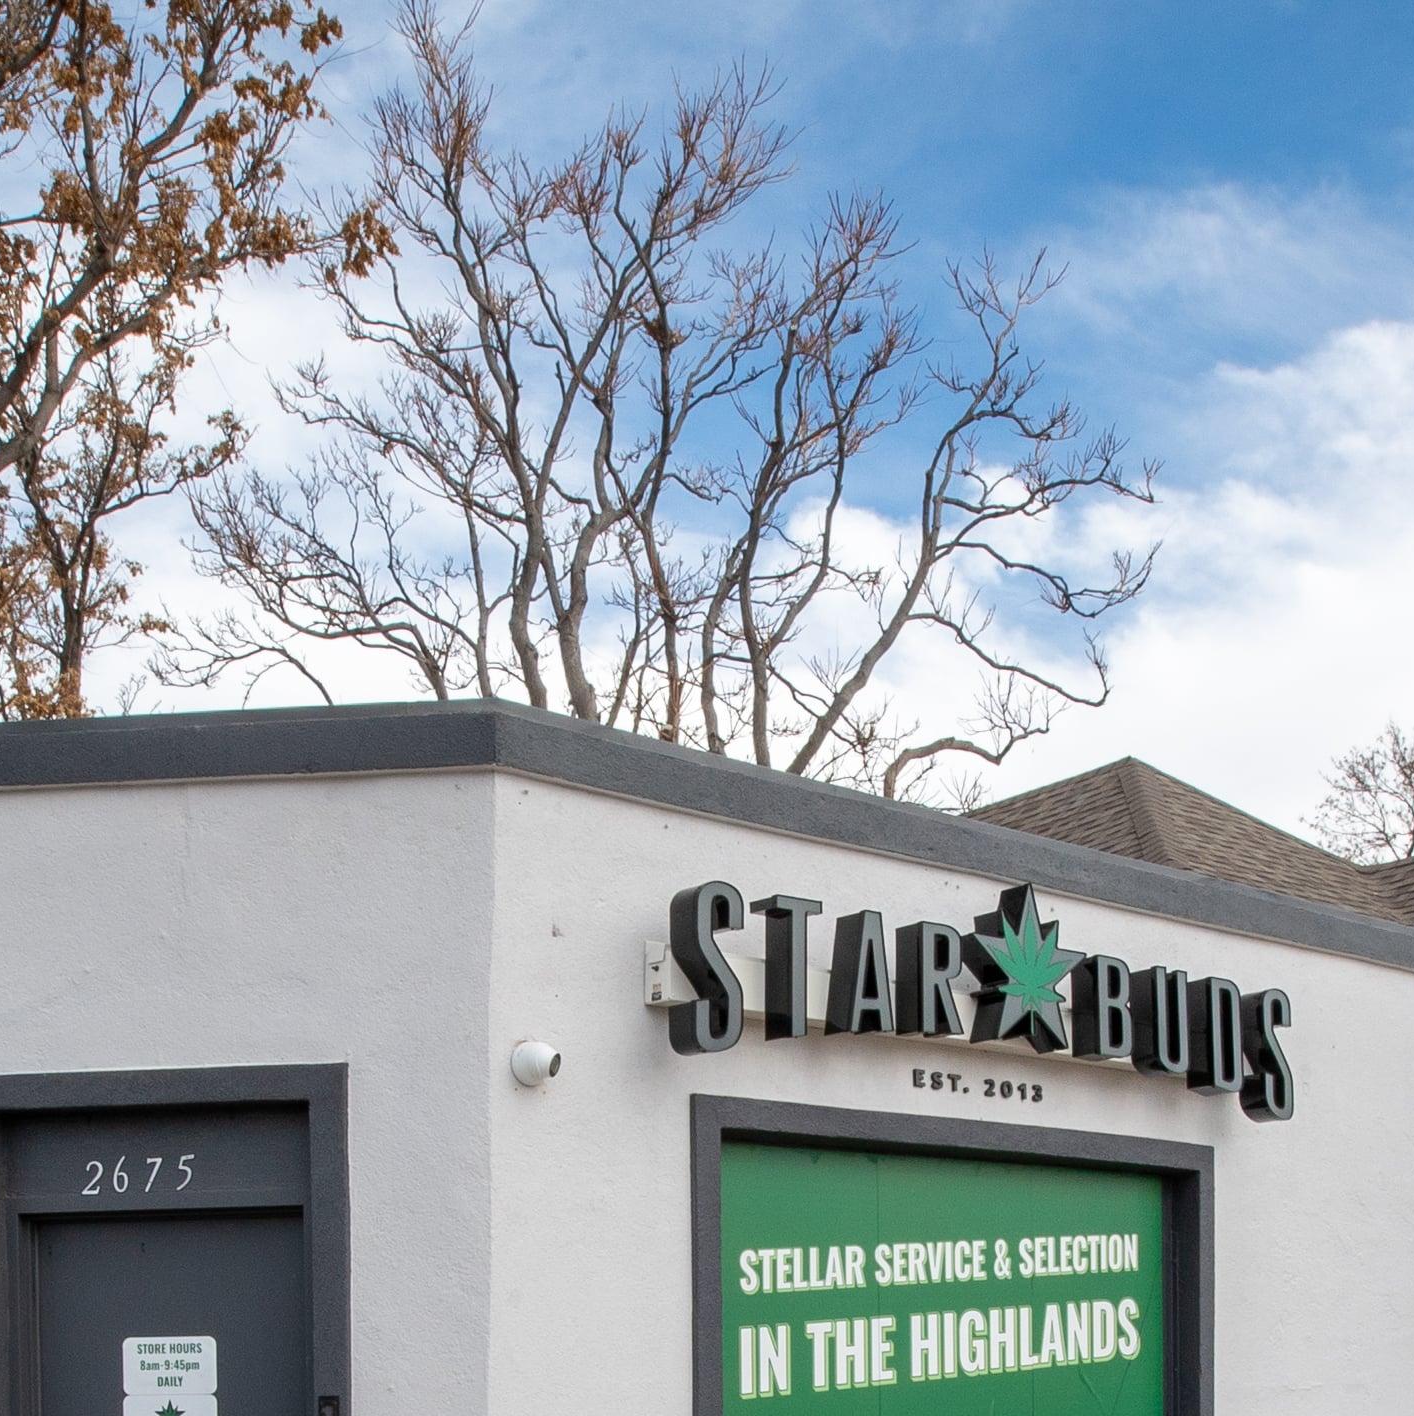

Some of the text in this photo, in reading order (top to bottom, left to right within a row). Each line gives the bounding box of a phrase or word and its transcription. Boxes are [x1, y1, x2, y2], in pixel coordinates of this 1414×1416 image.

[670, 880, 1294, 1122] STAR BUDS
[912, 1068, 1044, 1103] EST. 2013
[81, 1153, 195, 1195] 2675
[739, 1233, 1140, 1294] STELLAR SERVICE & SELECTION
[137, 1343, 203, 1354] STORE HOURS
[139, 1359, 201, 1372] 8am-9:45pm
[738, 1296, 1142, 1400] IN THE HIGHLANDS
[157, 1376, 184, 1387] DAILY
